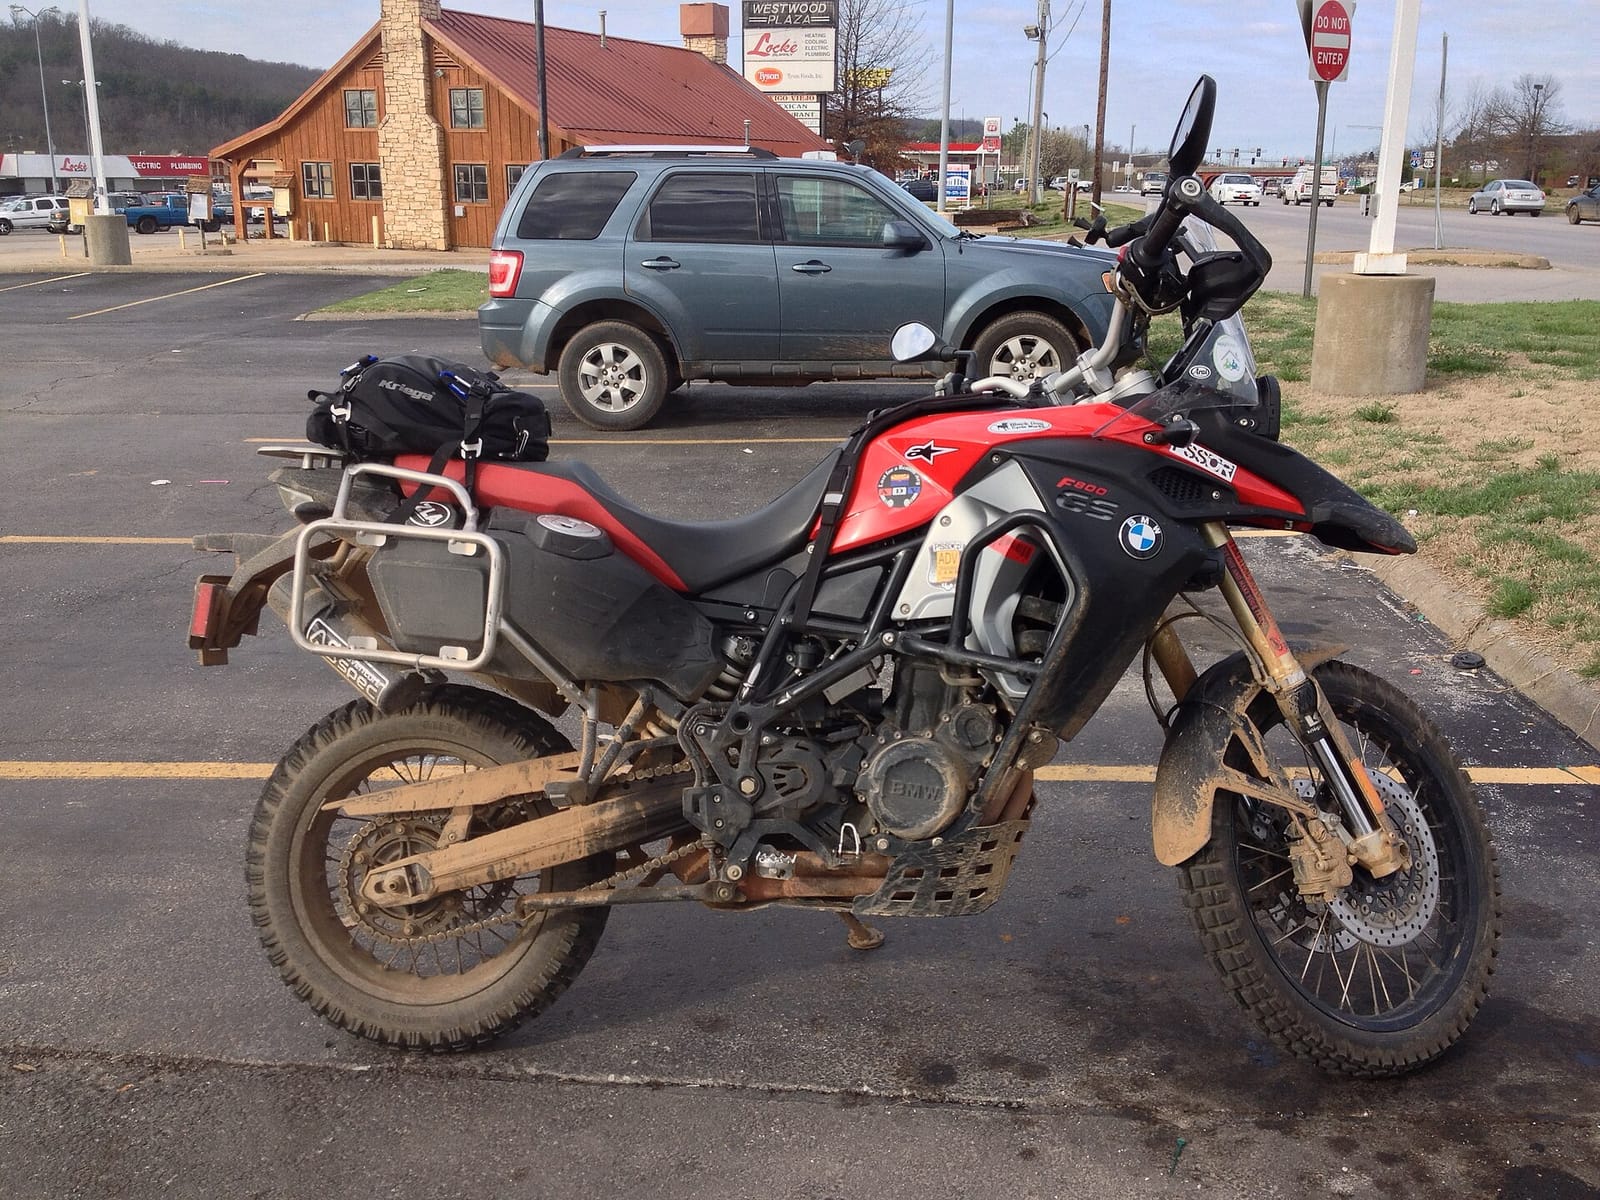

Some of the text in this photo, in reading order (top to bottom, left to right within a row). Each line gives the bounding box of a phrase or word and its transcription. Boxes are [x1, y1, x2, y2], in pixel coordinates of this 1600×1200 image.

[753, 3, 827, 14] WESTWOOD
[767, 14, 811, 25] PLAZA
[1317, 15, 1347, 30] DO NOT
[747, 32, 798, 57] Locke
[1317, 51, 1344, 65] ENTER
[758, 71, 780, 83] Tyson
[170, 162, 202, 170] PLUMBING
[378, 379, 433, 402] Kriega
[1056, 477, 1108, 496] F800
[1055, 490, 1119, 521] GS
[1127, 515, 1162, 535] BMW
[938, 552, 959, 565] ADV
[891, 780, 941, 801] BMW
